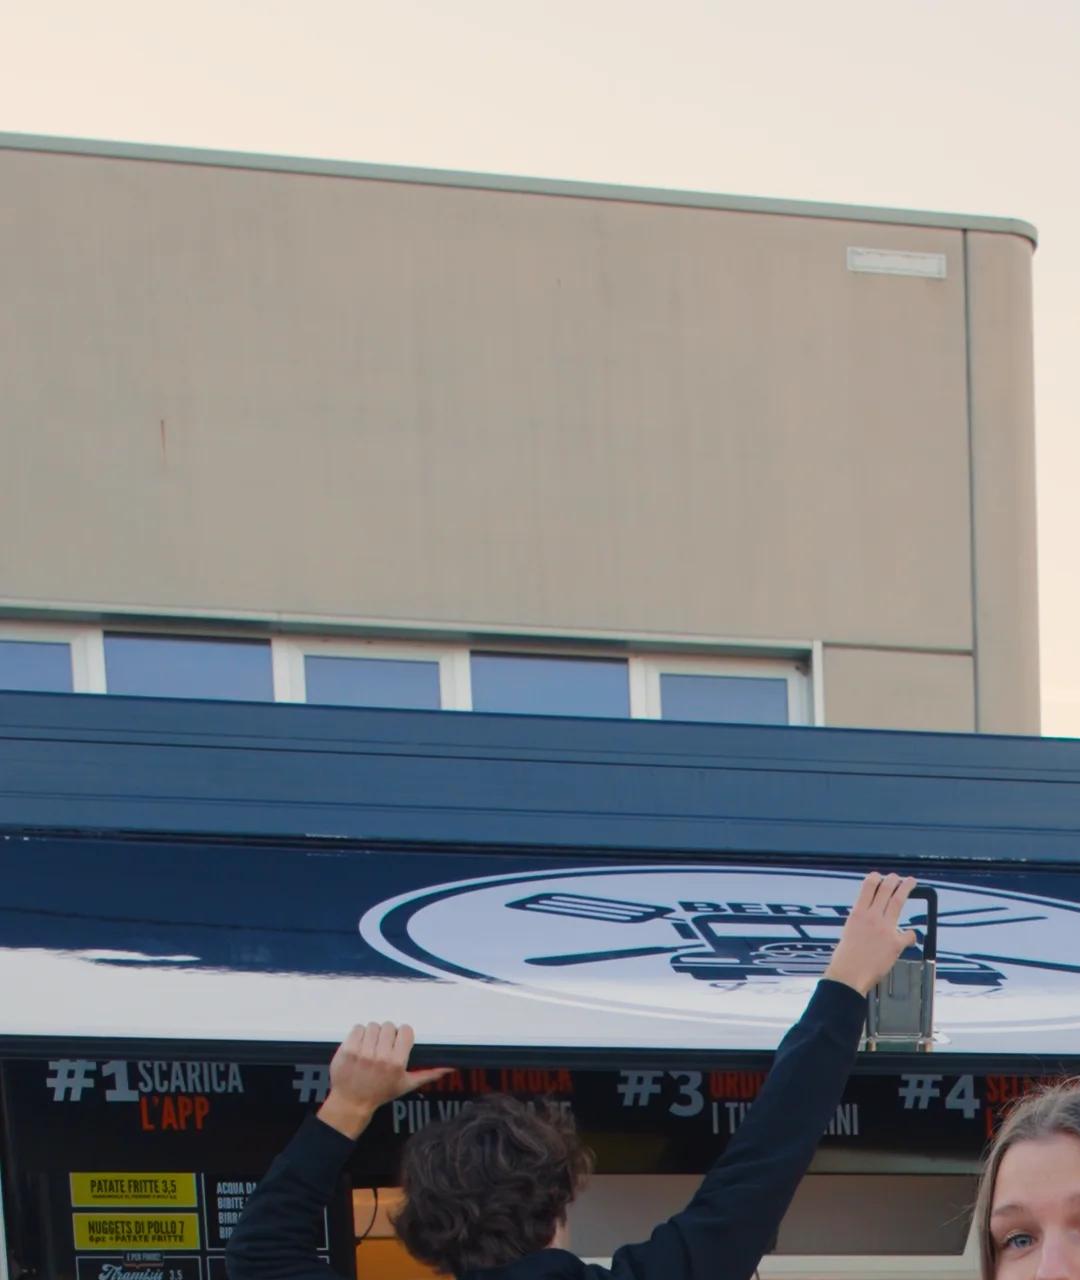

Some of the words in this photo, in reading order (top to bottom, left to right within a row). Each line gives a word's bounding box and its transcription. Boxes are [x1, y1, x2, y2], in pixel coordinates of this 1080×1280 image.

[678, 901, 852, 916] BERT
[46, 1059, 139, 1101] #1
[138, 1061, 244, 1093] SCARICA
[617, 1070, 704, 1117] #3
[898, 1074, 980, 1119] #4
[141, 1096, 210, 1130] L'APP
[90, 1180, 125, 1193] PATATE
[128, 1180, 159, 1193] FRITTE
[162, 1180, 177, 1195] 3,5
[216, 1182, 244, 1194] ACQUA
[88, 1221, 132, 1234] NUGGETS
[134, 1221, 145, 1234] DI
[147, 1221, 176, 1234] POLLO
[178, 1221, 185, 1234] 7
